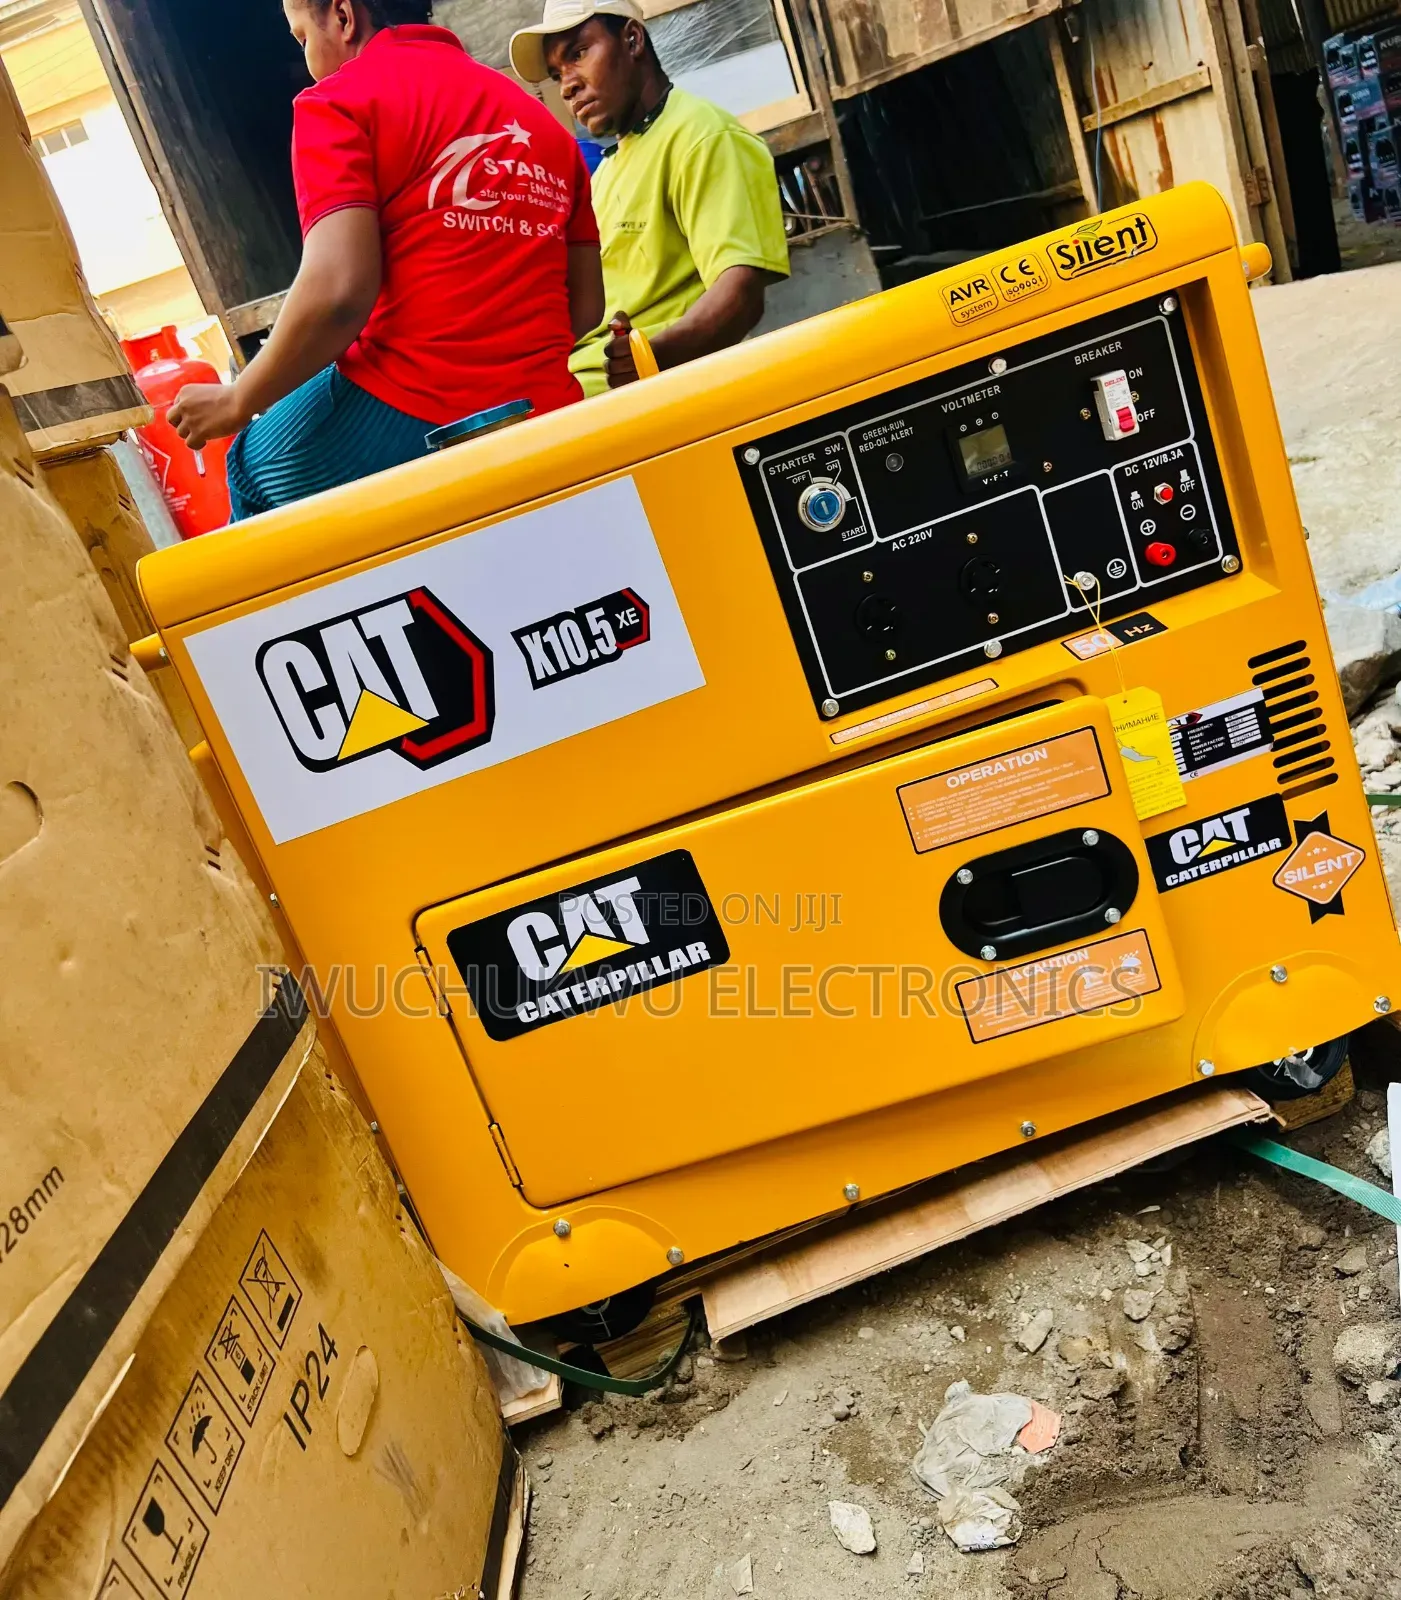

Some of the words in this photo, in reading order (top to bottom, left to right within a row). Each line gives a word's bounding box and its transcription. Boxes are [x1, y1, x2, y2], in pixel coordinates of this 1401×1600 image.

[483, 157, 548, 184] STAR
[501, 190, 525, 202] Your
[443, 211, 515, 234] SWITCH
[520, 219, 533, 237] &
[1055, 217, 1148, 271] Silent
[950, 279, 990, 306] AVR
[960, 300, 993, 319] system
[1074, 341, 1123, 365] BREAKER
[1128, 367, 1143, 379] ON
[941, 384, 1001, 413] VOLTMETER
[862, 419, 906, 441] GREEN-RUN
[1137, 408, 1156, 423] OFF
[858, 436, 889, 453] RED-OIL
[889, 427, 915, 445] ALERT
[768, 452, 816, 476] STARTER
[824, 442, 844, 456] SW.
[826, 462, 838, 472] ON
[1124, 463, 1140, 478] DC
[1142, 449, 1184, 471] 12V/8.3A
[791, 473, 807, 485] OFF
[1179, 480, 1196, 494] OFF
[1131, 499, 1145, 511] ON
[841, 525, 864, 540] START
[891, 537, 908, 552] AC
[908, 528, 934, 547] 220V
[521, 606, 618, 682] X10.5
[615, 607, 641, 630] XE
[1072, 633, 1115, 655] 50
[1123, 623, 1154, 637] Hz
[262, 598, 440, 762] CAT
[946, 747, 1049, 789] OPERATION
[1168, 807, 1250, 865] CAT
[1165, 837, 1282, 887] CATERPILLAR
[1283, 851, 1355, 886] SILENT
[506, 876, 650, 982] CAT
[1022, 948, 1090, 979] CAUTION
[515, 940, 711, 1024] CATERPILLAR
[0, 1166, 65, 1263] 28mm
[246, 1385, 261, 1412] STACK
[258, 1362, 269, 1389] LIMIT
[283, 1322, 339, 1452] IP24
[214, 1464, 227, 1493] KEEP
[224, 1444, 236, 1467] DRY
[177, 1542, 197, 1588] FRAGILE
